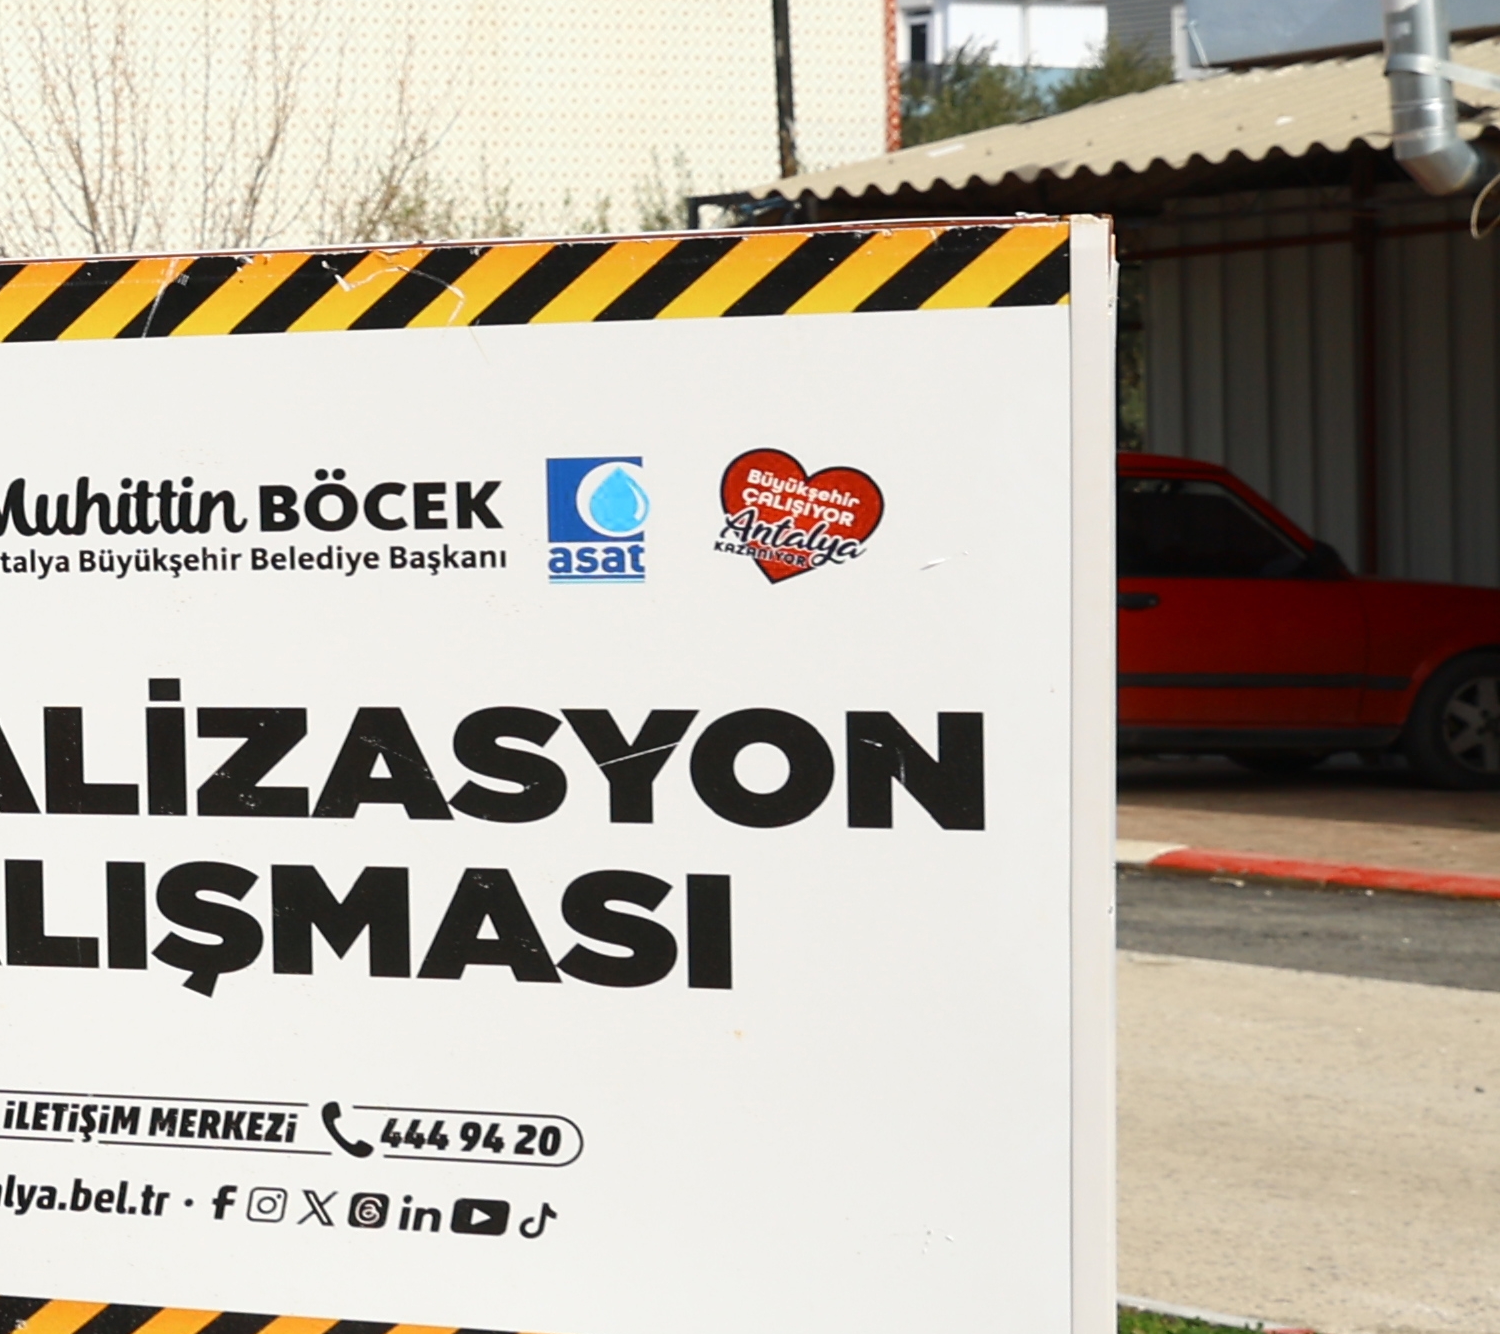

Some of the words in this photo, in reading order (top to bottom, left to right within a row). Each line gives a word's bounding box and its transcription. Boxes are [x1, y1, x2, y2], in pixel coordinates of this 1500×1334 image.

[259, 468, 504, 532] BÖCEK
[742, 488, 854, 527] ÇALIŞIYOR
[747, 469, 860, 507] Büyükşehir
[720, 508, 867, 566] Antalya
[80, 546, 242, 578] Büyükşehir
[251, 545, 380, 576] Belediye
[389, 543, 507, 575] Başkanı
[548, 544, 645, 573] asat
[380, 1118, 449, 1151] 444
[459, 1122, 505, 1154] 94
[513, 1124, 563, 1157] 20
